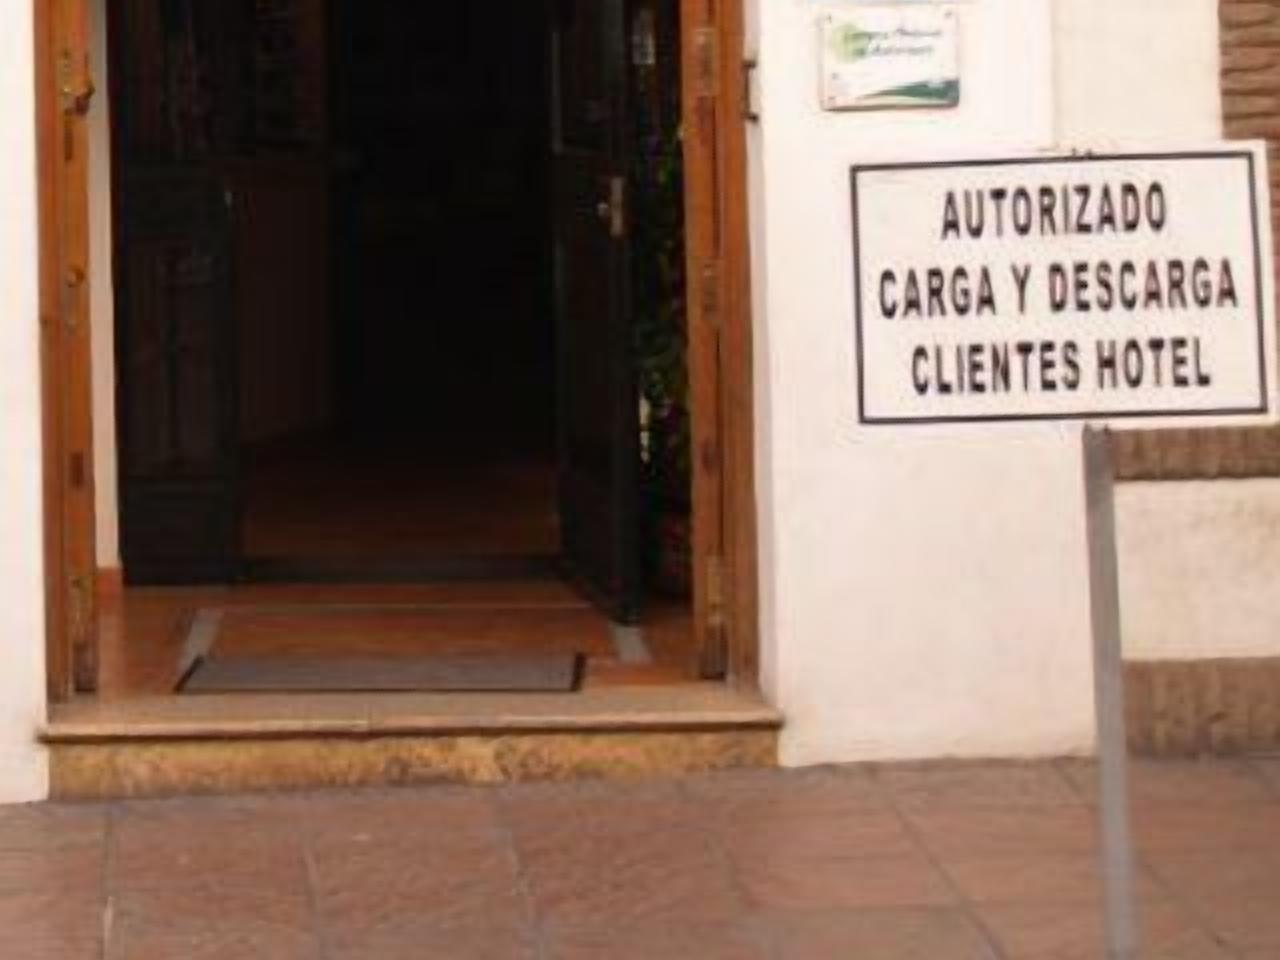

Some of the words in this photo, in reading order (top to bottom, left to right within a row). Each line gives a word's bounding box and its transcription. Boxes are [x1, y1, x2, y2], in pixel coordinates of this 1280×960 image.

[940, 181, 1167, 240] AUTORIZADO
[878, 265, 997, 319] CARGA
[1011, 263, 1032, 314] Y
[1048, 256, 1239, 313] DESCARGA
[911, 339, 1081, 395] CLIENTES
[1096, 336, 1212, 390] HOTEL
